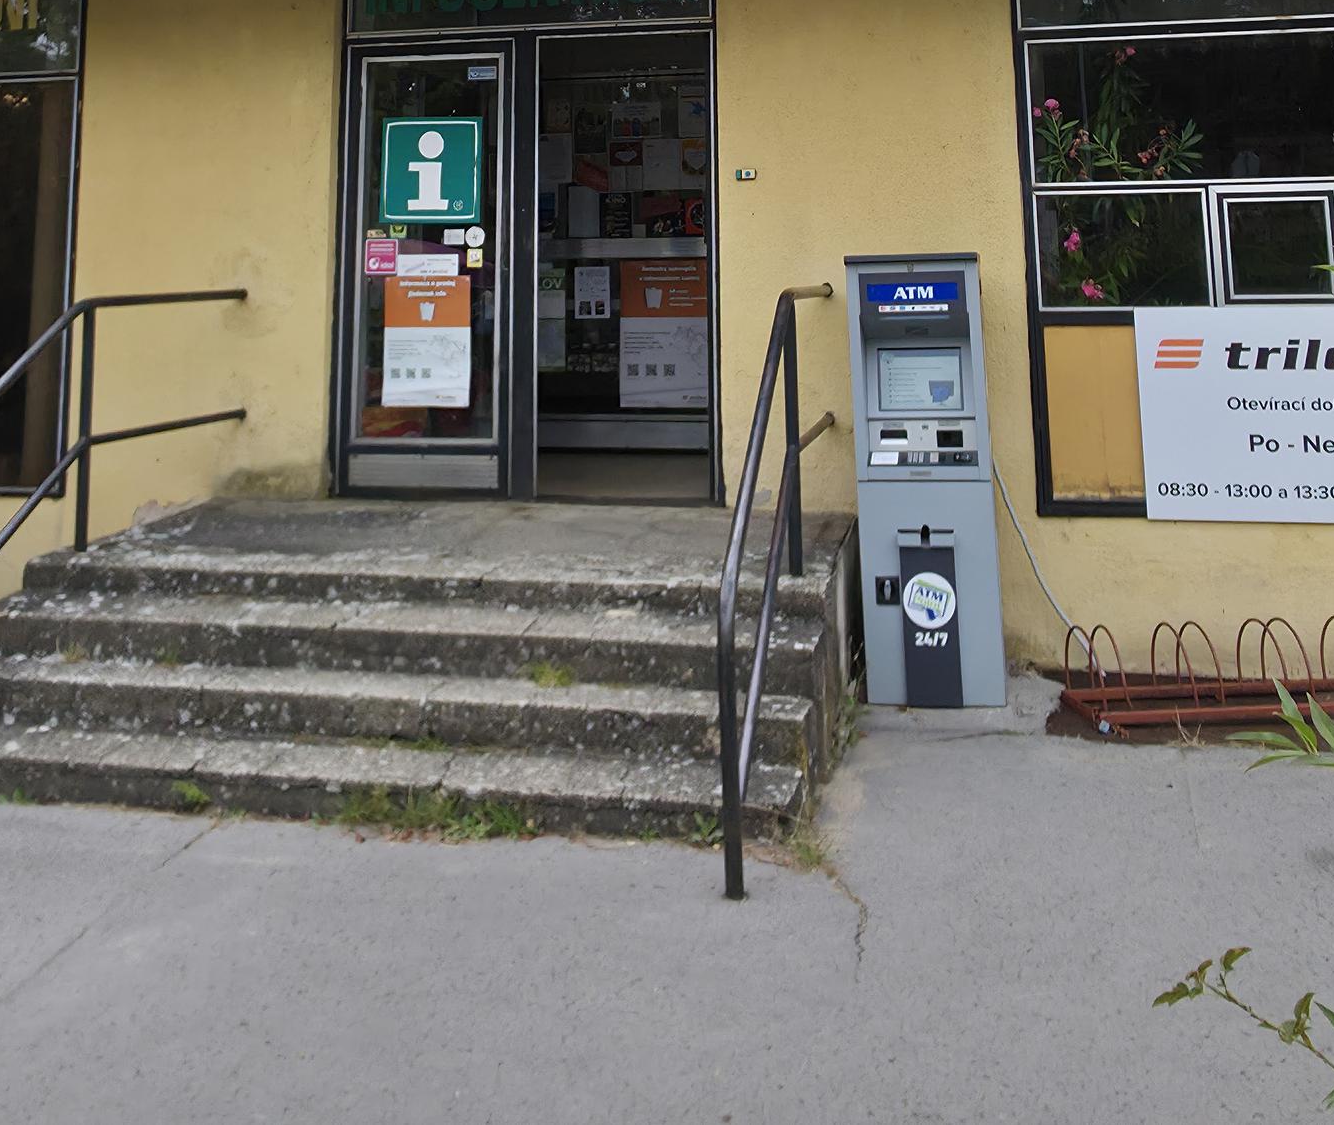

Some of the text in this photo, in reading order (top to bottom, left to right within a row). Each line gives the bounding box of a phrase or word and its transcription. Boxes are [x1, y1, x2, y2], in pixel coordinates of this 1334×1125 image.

[893, 285, 934, 300] ATM
[1227, 396, 1306, 412] Otevírací
[1249, 434, 1280, 453] Po
[1157, 483, 1209, 497] 08:30
[1226, 484, 1273, 499] 13:00
[1278, 488, 1288, 499] a
[915, 586, 944, 602] ATM
[915, 632, 948, 647] 24/7
